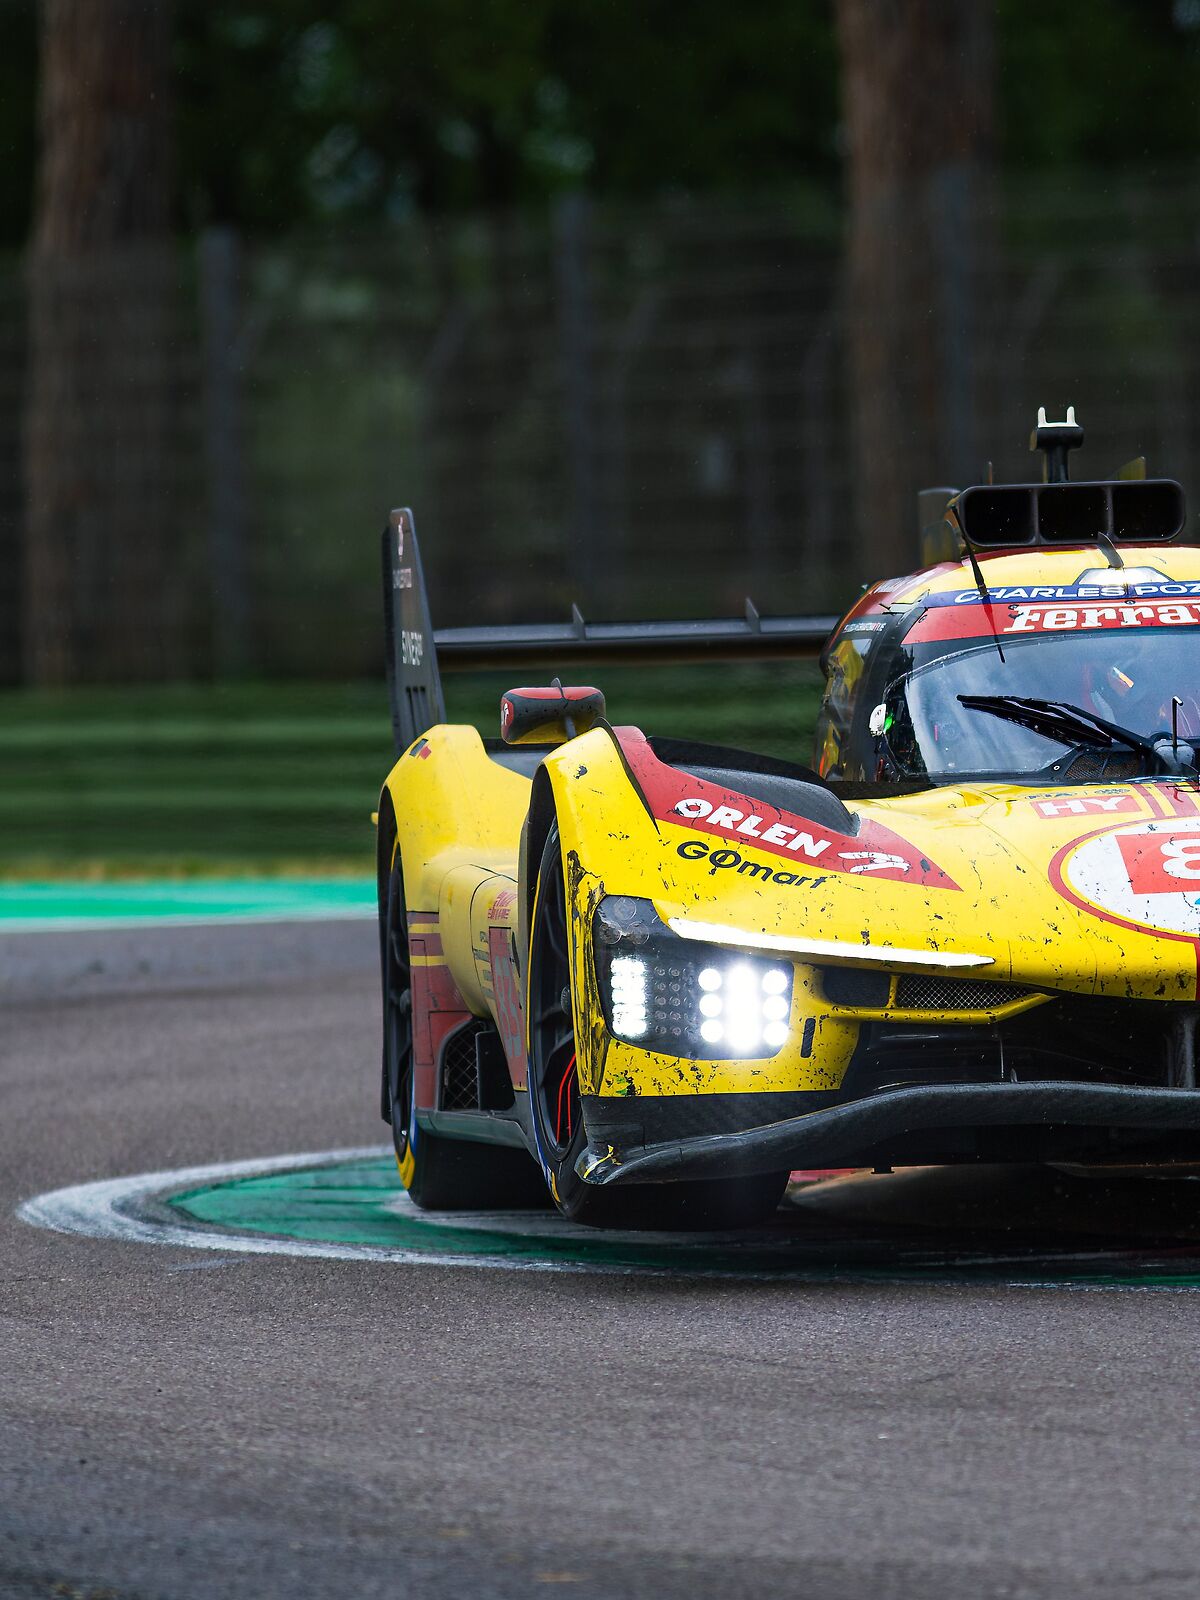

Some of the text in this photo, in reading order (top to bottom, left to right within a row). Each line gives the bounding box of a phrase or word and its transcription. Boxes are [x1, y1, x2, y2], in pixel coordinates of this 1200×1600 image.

[954, 585, 1126, 603] CHARLES
[1038, 796, 1126, 816] HY
[674, 798, 832, 858] ORLEN
[676, 841, 827, 889] GOmart
